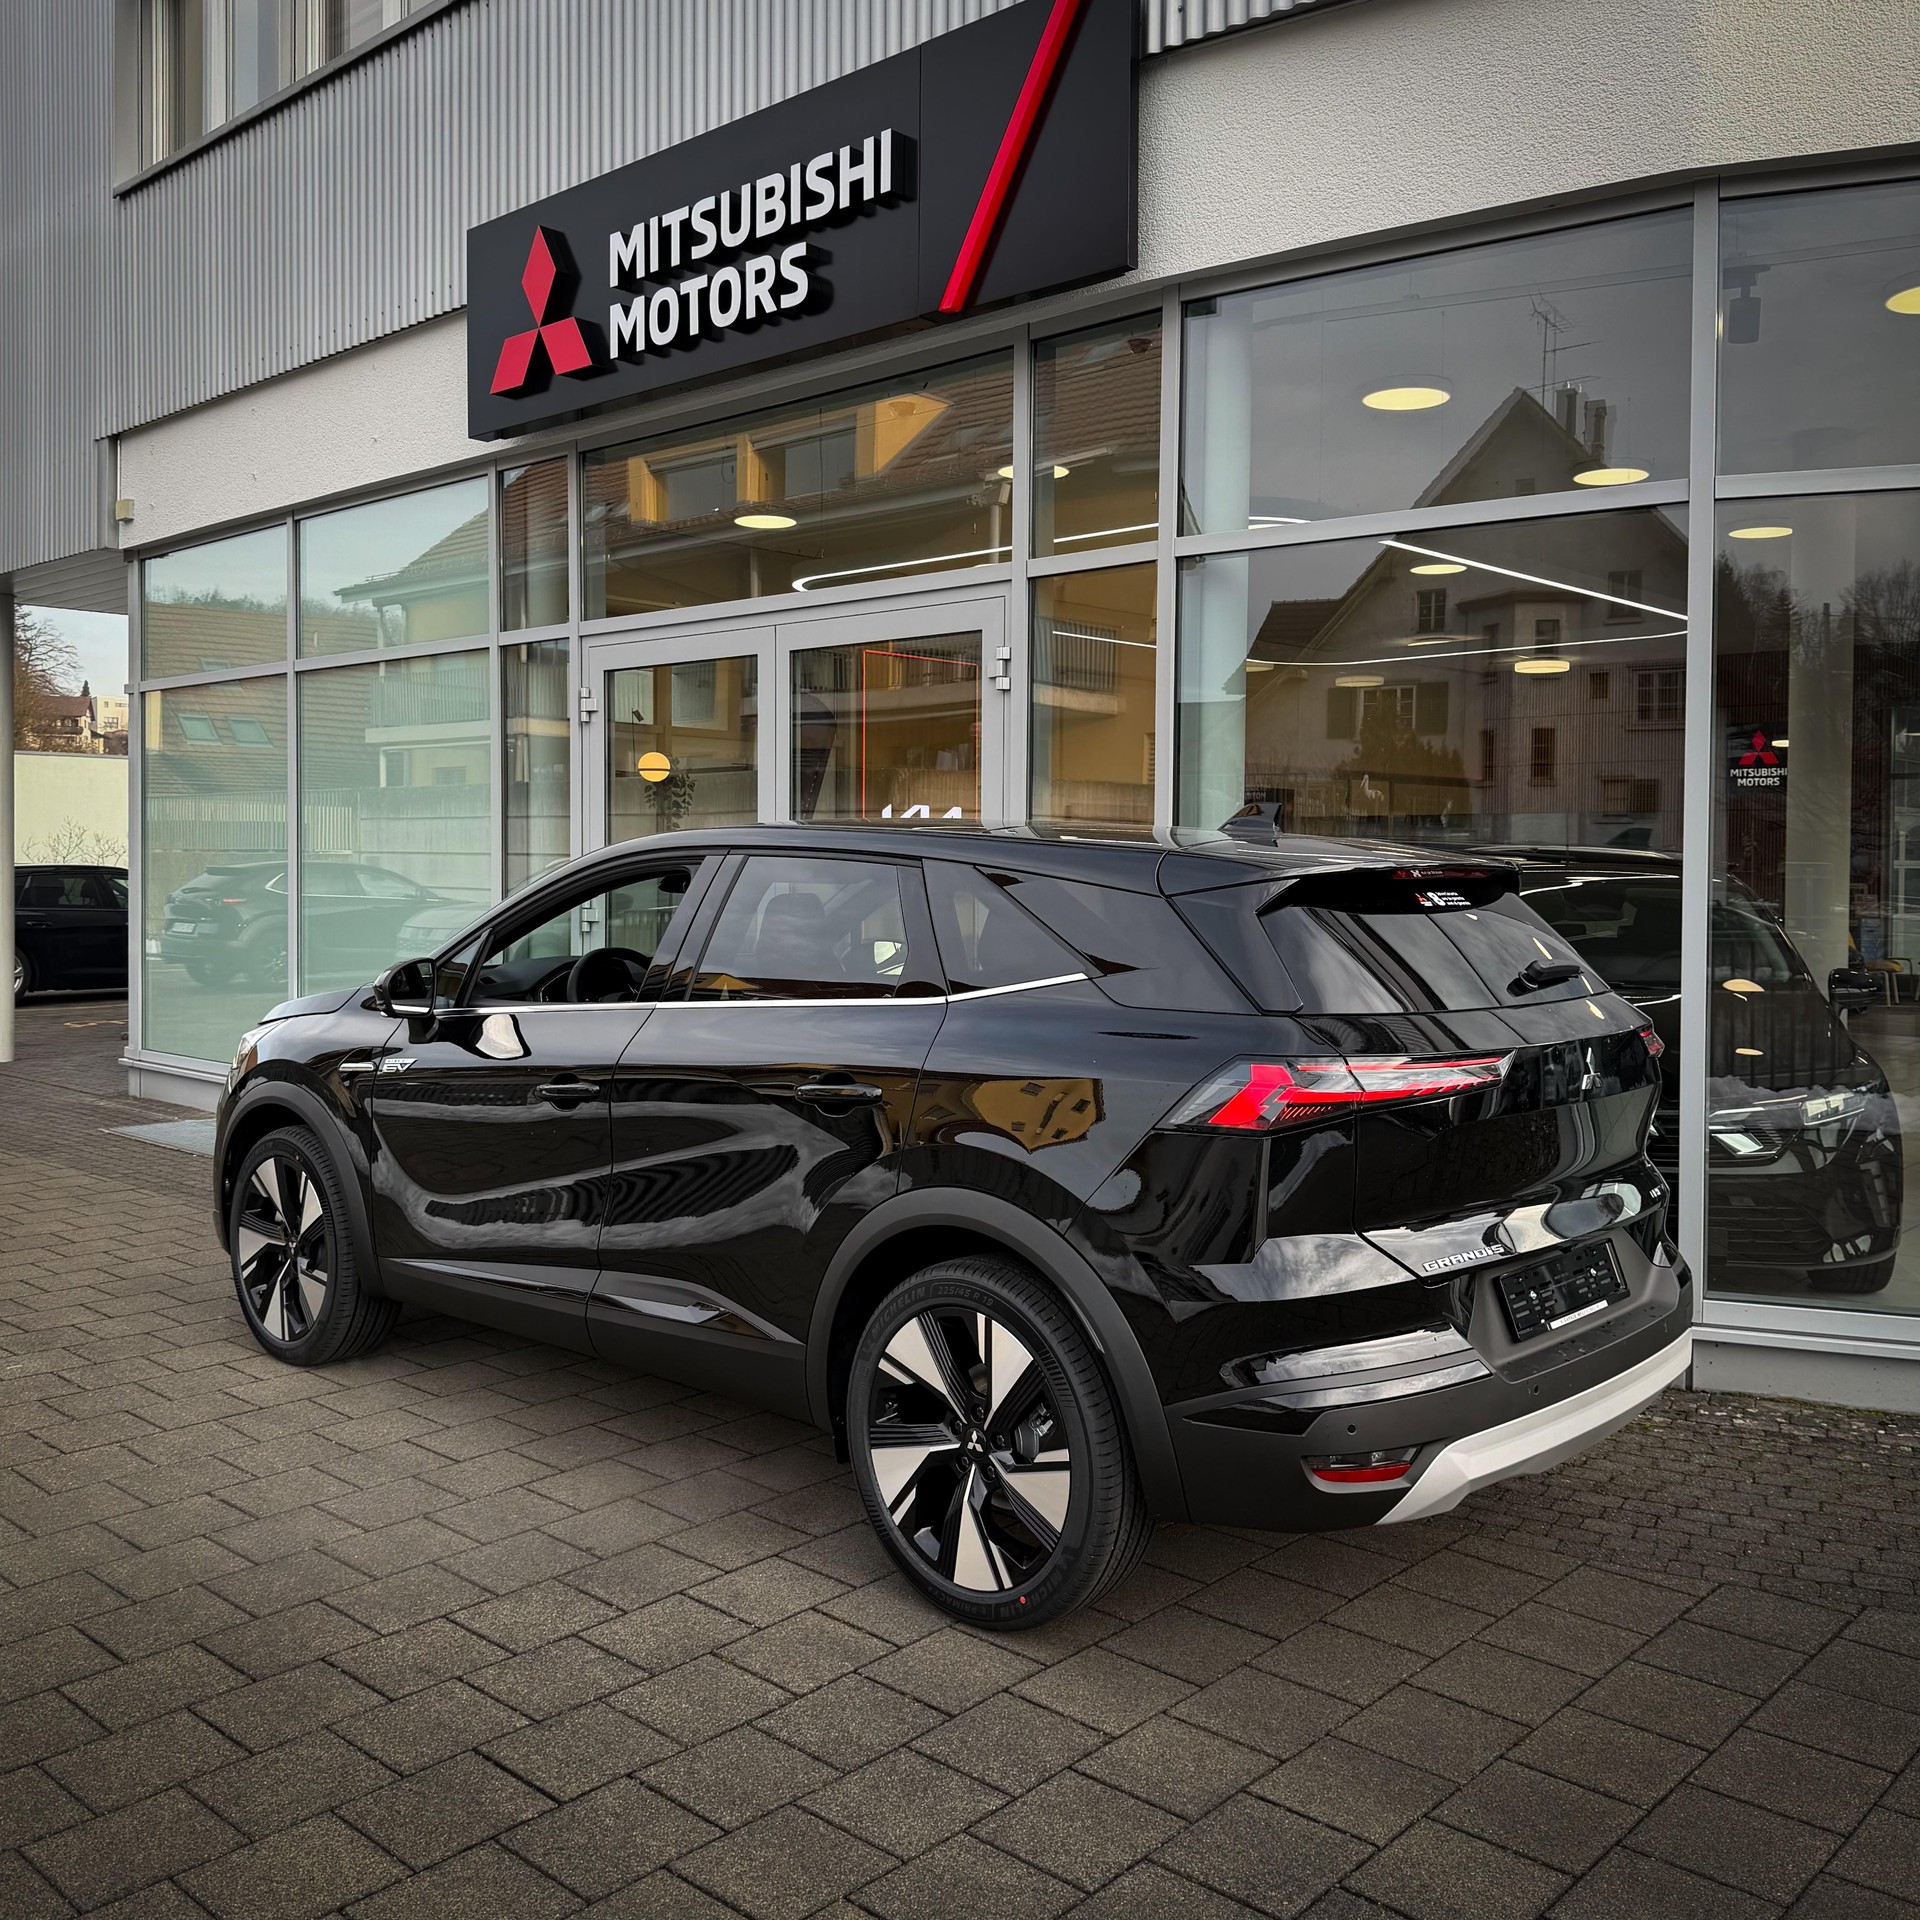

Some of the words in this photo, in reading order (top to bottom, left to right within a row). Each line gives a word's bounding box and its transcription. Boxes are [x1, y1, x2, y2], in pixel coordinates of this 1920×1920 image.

[609, 128, 892, 288] MITSUBISHI
[609, 242, 809, 359] MOTORS
[1730, 768, 1788, 777] MITSUBISHI
[1737, 777, 1780, 787] MOTORS
[1422, 1244, 1505, 1272] GRANDIS
[872, 1286, 926, 1338] MICHELIN
[937, 1286, 971, 1297] 225/45
[973, 1292, 980, 1300] R
[982, 1296, 994, 1306] 19
[1000, 1568, 1063, 1618] MICHELIN
